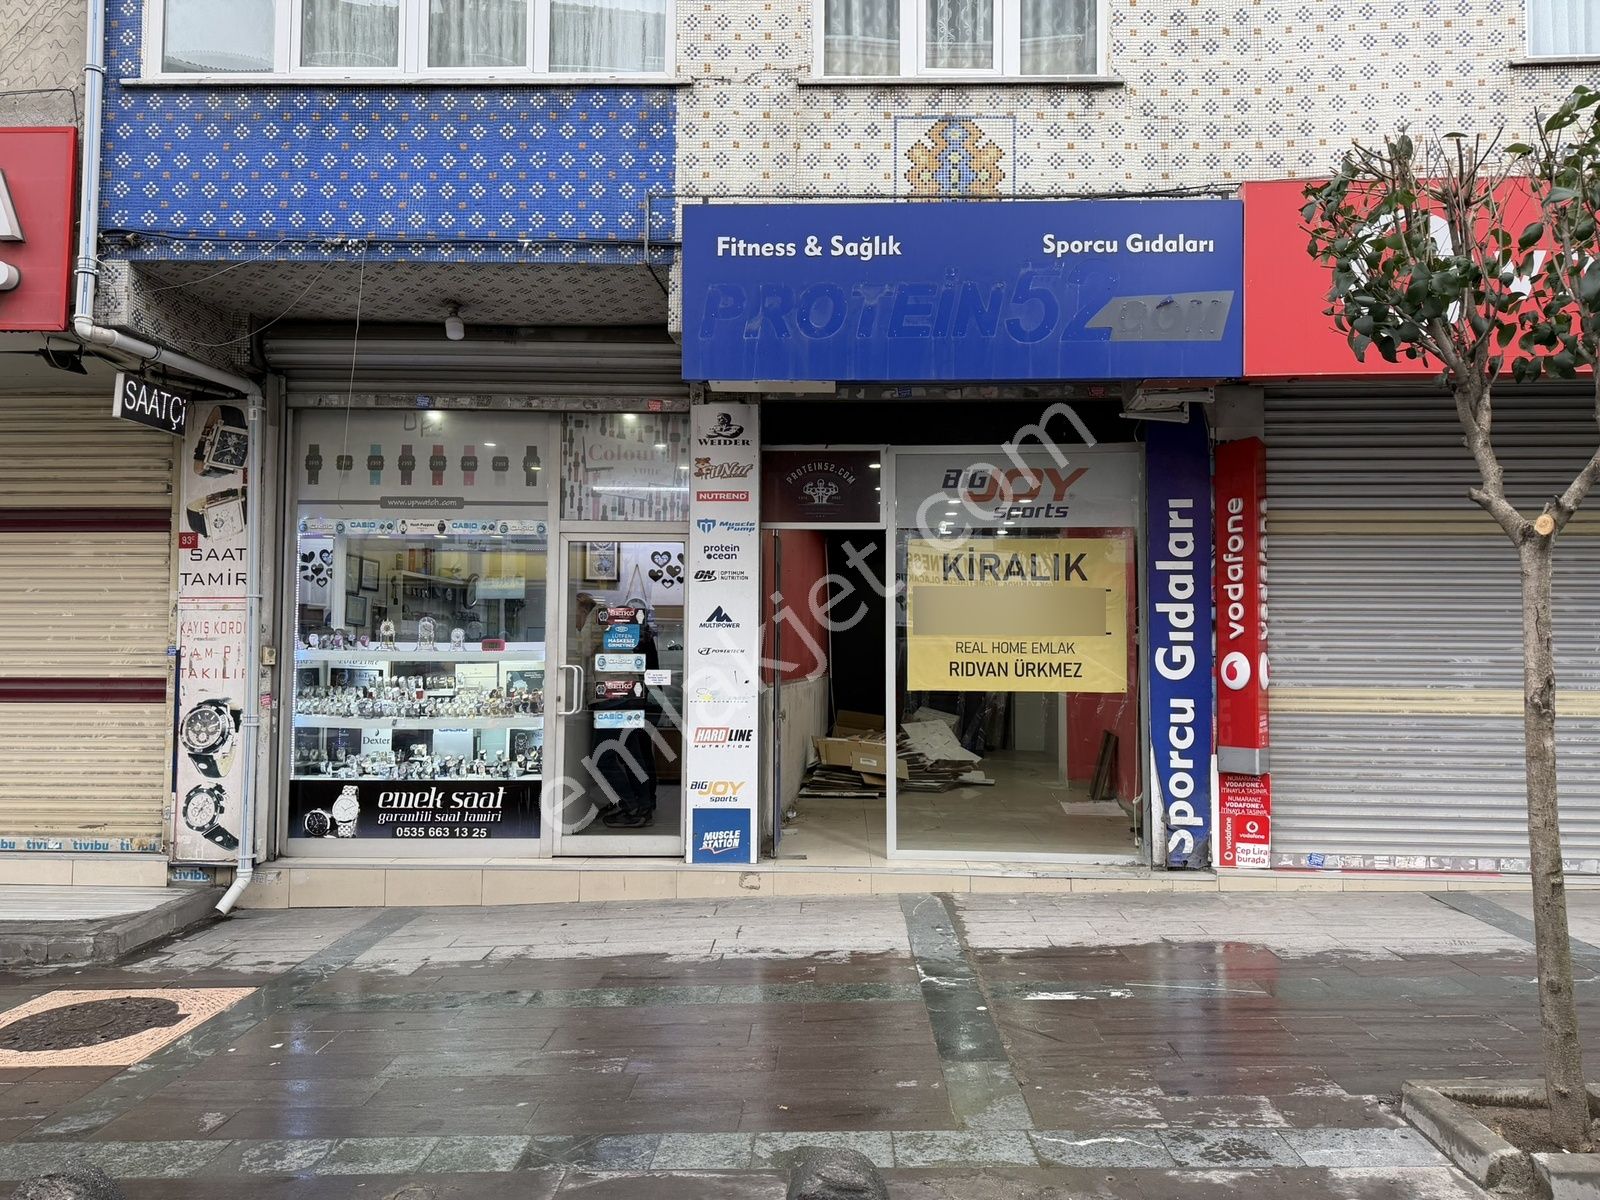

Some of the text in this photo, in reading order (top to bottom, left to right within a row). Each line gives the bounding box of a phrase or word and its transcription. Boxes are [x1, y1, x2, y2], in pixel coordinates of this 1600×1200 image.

[717, 235, 902, 261] Fitness & Sağlık
[1043, 233, 1214, 258] Sporcu Gıdaları
[590, 443, 660, 462] Colour
[786, 461, 857, 485] PROTEIN52.COM
[965, 467, 1089, 503] JOY
[387, 498, 458, 507] www.upwatch.com
[993, 503, 1069, 521] sports
[190, 548, 247, 562] SAAT
[704, 544, 740, 553] protein
[943, 547, 1088, 581] KİRALIK
[1223, 497, 1245, 640] vodafone
[955, 641, 1076, 654] REAL HOME EMLAK
[949, 659, 1083, 678] RIDVAN ÜRKMEZ
[1155, 498, 1204, 855] Sporcu Gıdaları
[363, 736, 391, 745] Dexter
[695, 729, 754, 742] HARD LINE
[698, 780, 746, 796] JOY
[378, 787, 507, 809] emek saat
[378, 811, 502, 825] garantili saat tamiri
[396, 827, 487, 838] 0535 663 13 25
[703, 830, 741, 840] MUSCLE
[1224, 817, 1232, 850] vodafone
[1239, 832, 1265, 840] vodafone
[26, 839, 63, 850] tiviu
[73, 840, 109, 851] tivibu
[120, 841, 156, 852] tibu
[702, 839, 740, 849] STATION
[1236, 846, 1252, 856] Cep
[1237, 856, 1266, 865] burada
